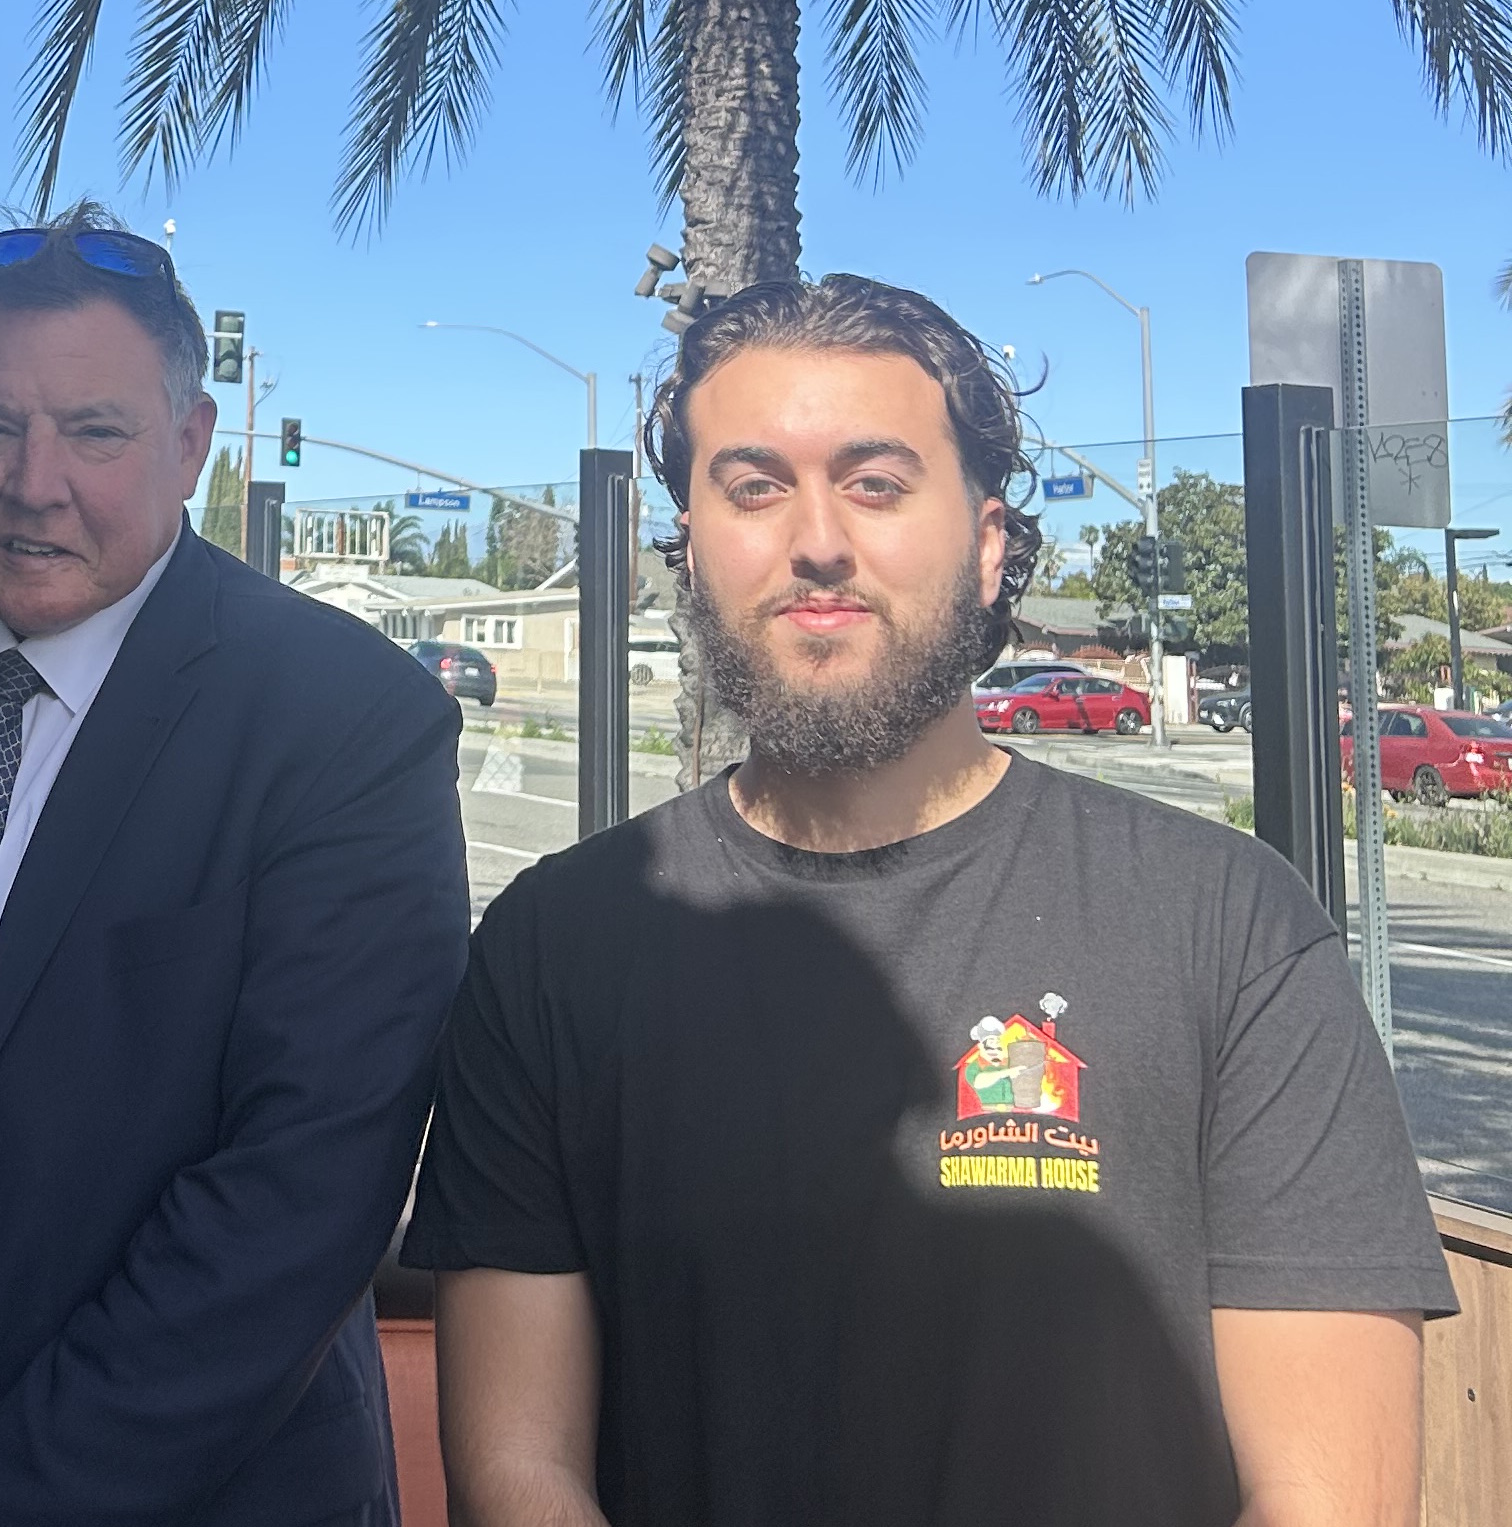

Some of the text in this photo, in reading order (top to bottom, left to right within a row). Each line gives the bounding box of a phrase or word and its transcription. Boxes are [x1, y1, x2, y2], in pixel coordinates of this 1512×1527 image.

[939, 1118, 1100, 1157] بيت الشاورما
[940, 1155, 1100, 1192] SHAWARMA HOUSE
